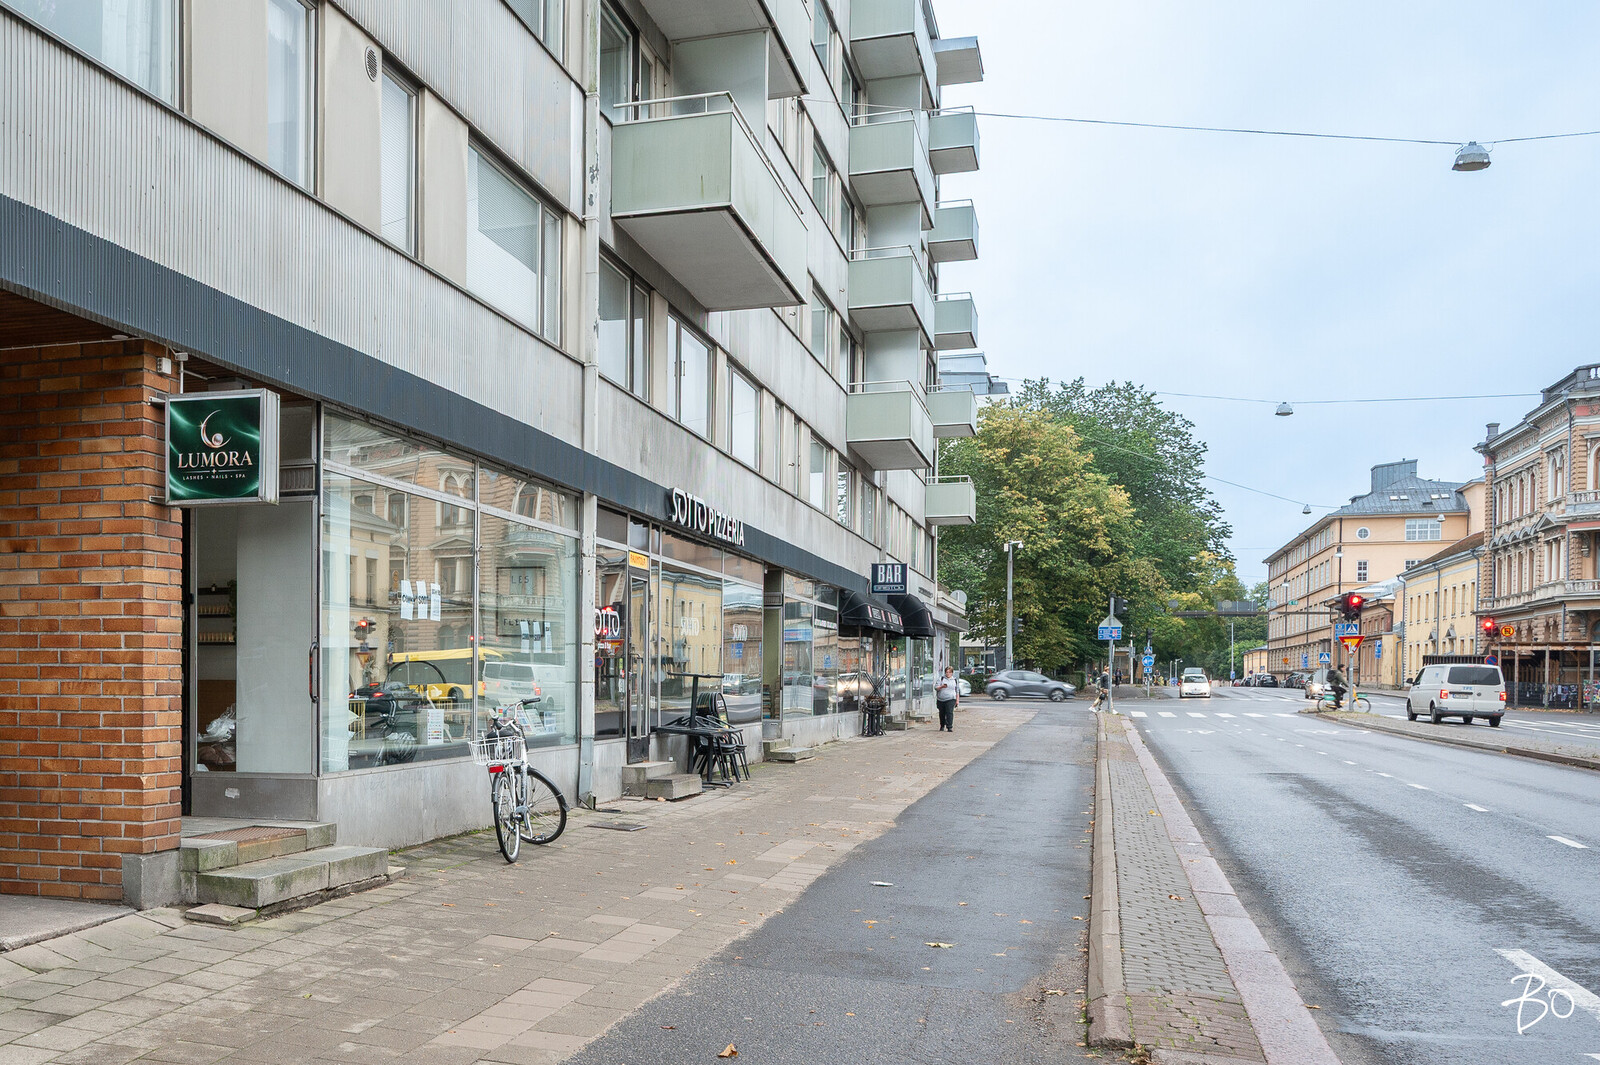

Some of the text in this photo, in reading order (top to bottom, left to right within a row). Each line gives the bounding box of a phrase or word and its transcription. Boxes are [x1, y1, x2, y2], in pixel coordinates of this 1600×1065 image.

[177, 451, 253, 468] LUMORA
[672, 487, 745, 546] SOTTO PIZZERIA
[878, 565, 902, 583] BAR
